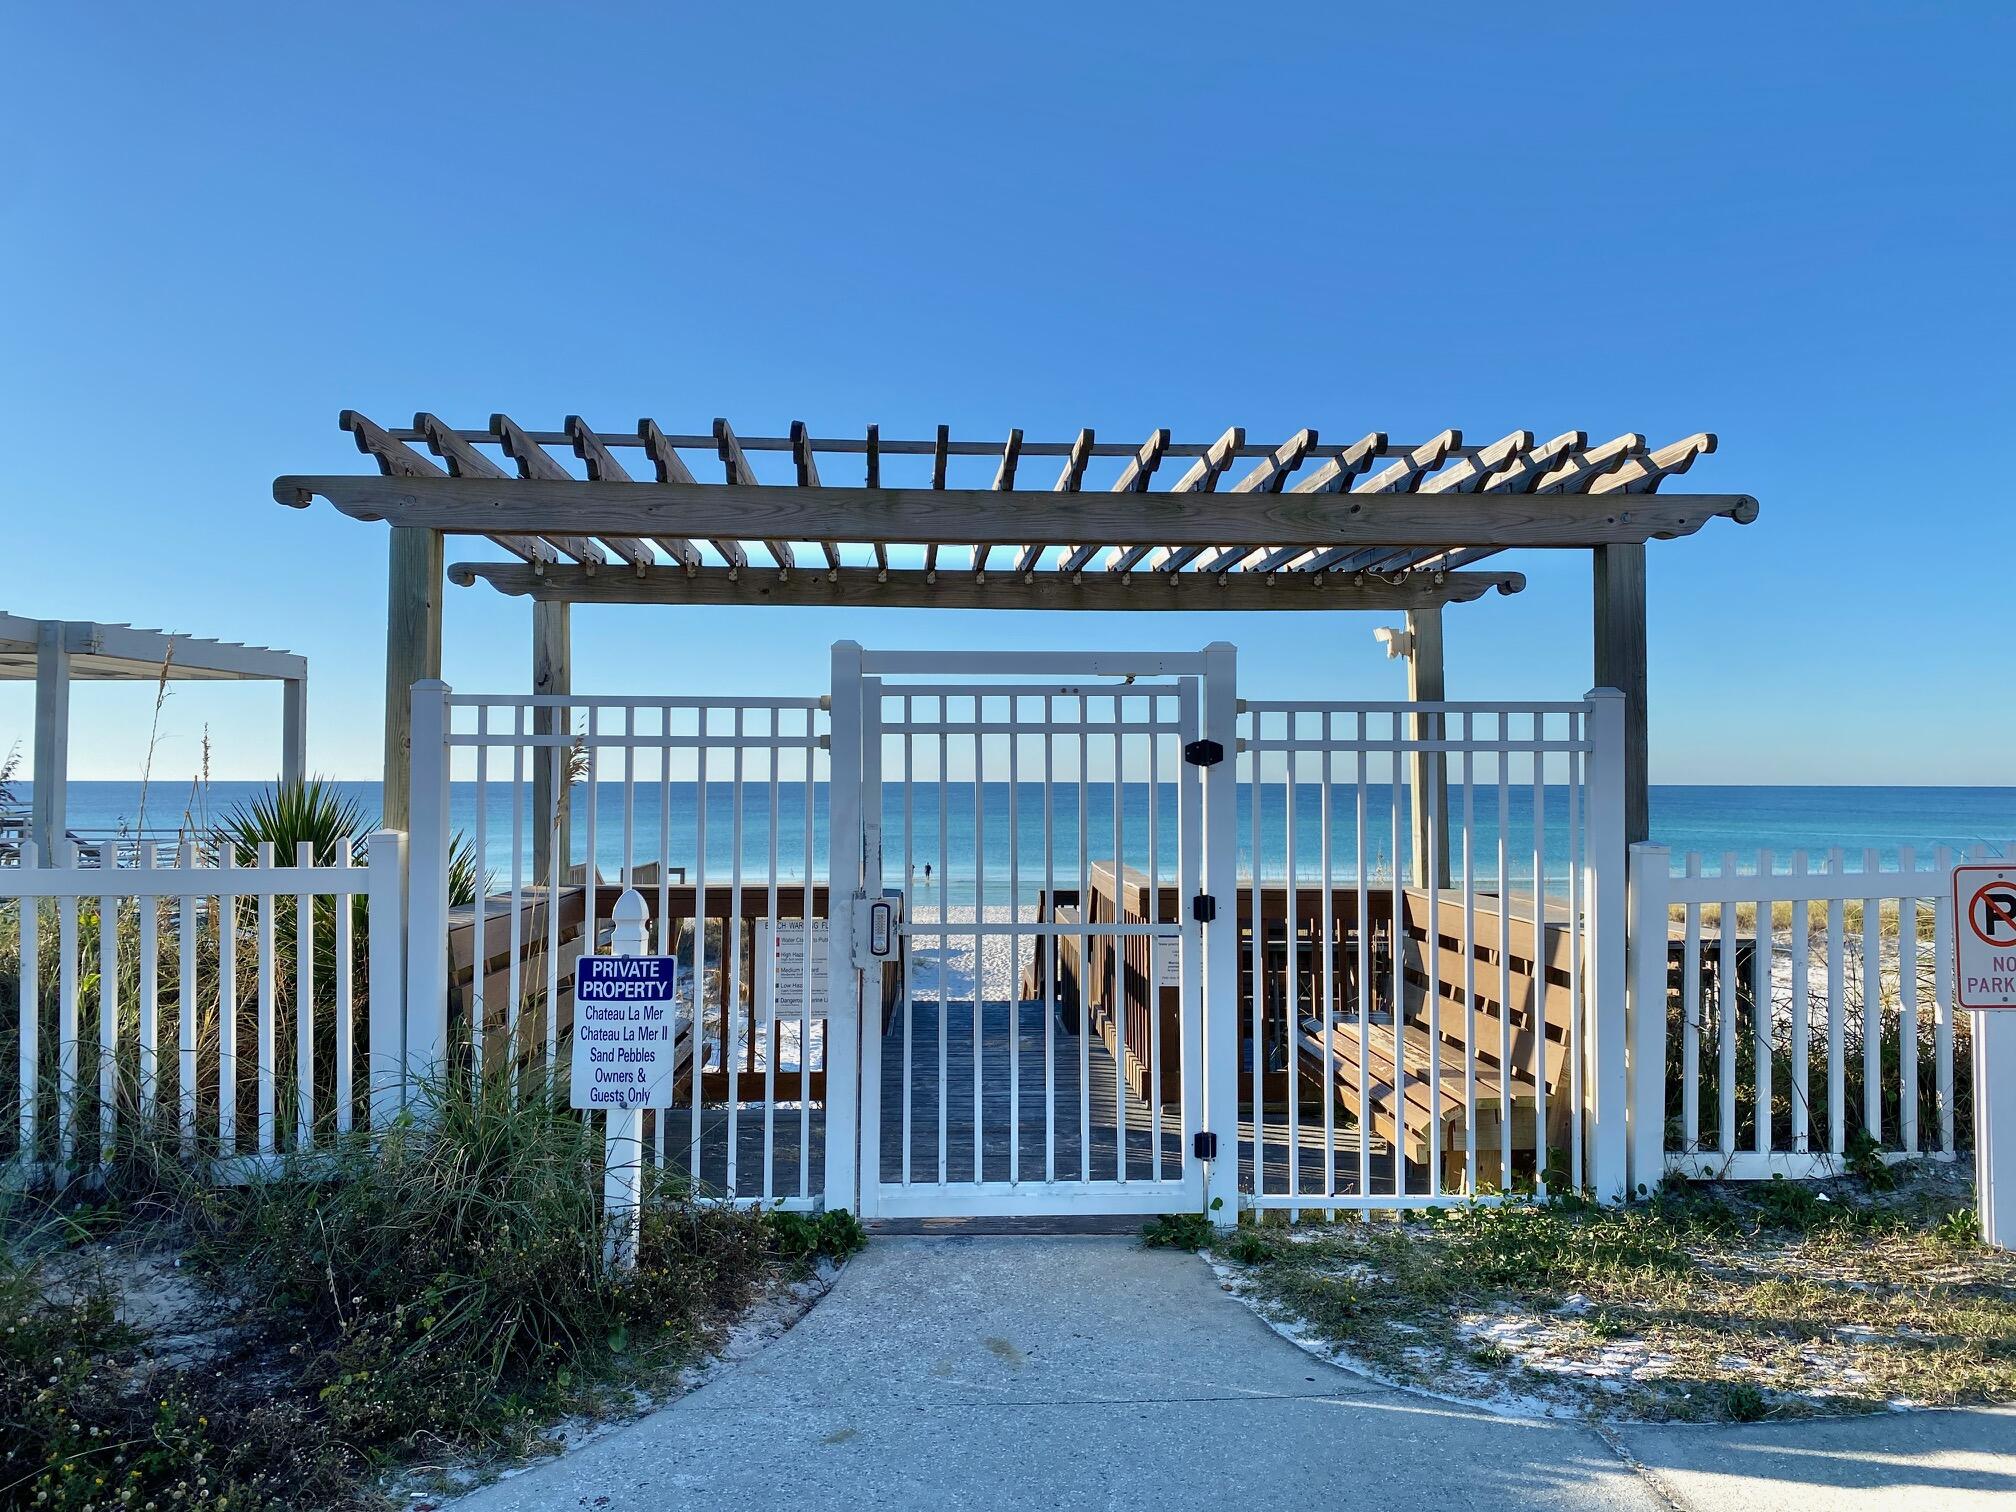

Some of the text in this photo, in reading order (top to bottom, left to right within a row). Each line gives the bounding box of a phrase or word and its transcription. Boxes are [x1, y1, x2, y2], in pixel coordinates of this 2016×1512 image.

[592, 961, 660, 978] PRIVATE
[1993, 956, 2016, 972] NO
[583, 981, 668, 998] PROPERTY
[1968, 977, 2016, 994] PARK
[585, 1005, 664, 1021] Chateau La Mer
[580, 1025, 668, 1041] Chateau La Mer II
[590, 1047, 655, 1062] Sand Pebbles
[595, 1067, 646, 1083] Owners &
[590, 1087, 650, 1105] Guests Only
